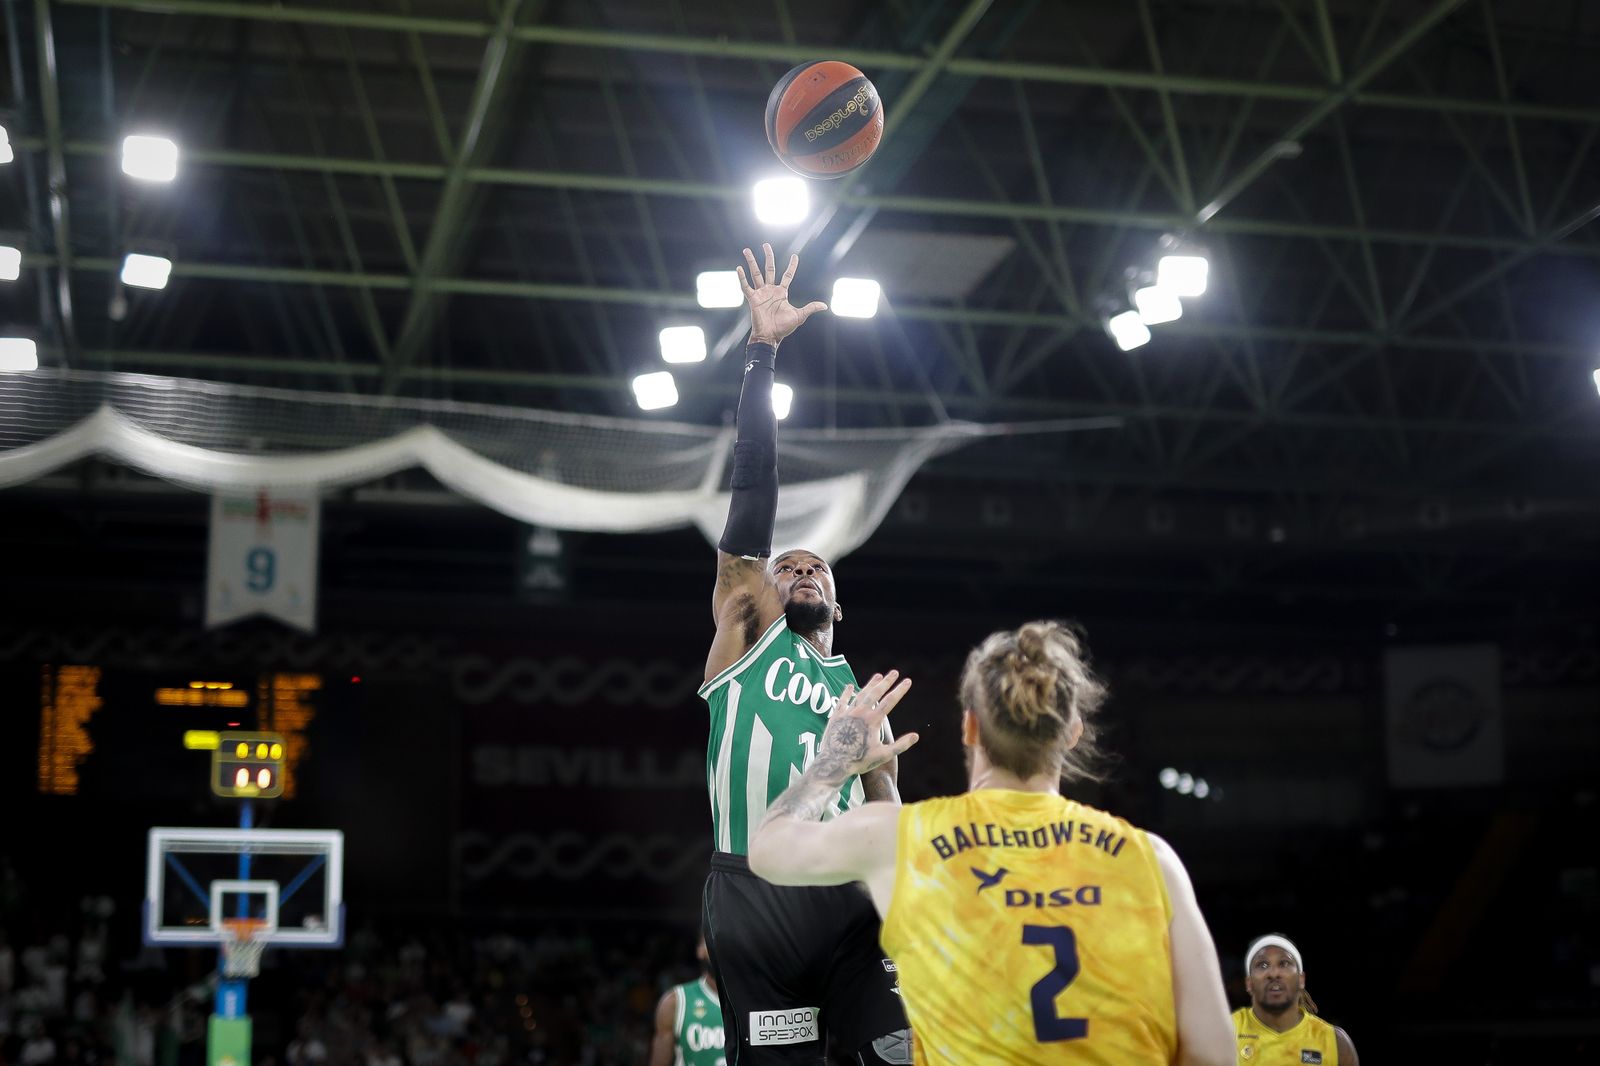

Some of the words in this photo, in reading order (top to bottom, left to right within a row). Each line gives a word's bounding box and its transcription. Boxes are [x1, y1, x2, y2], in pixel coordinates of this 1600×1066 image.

[246, 548, 275, 592] 9
[931, 820, 1128, 860] BALCEROWSKI
[1021, 924, 1089, 1043] 2
